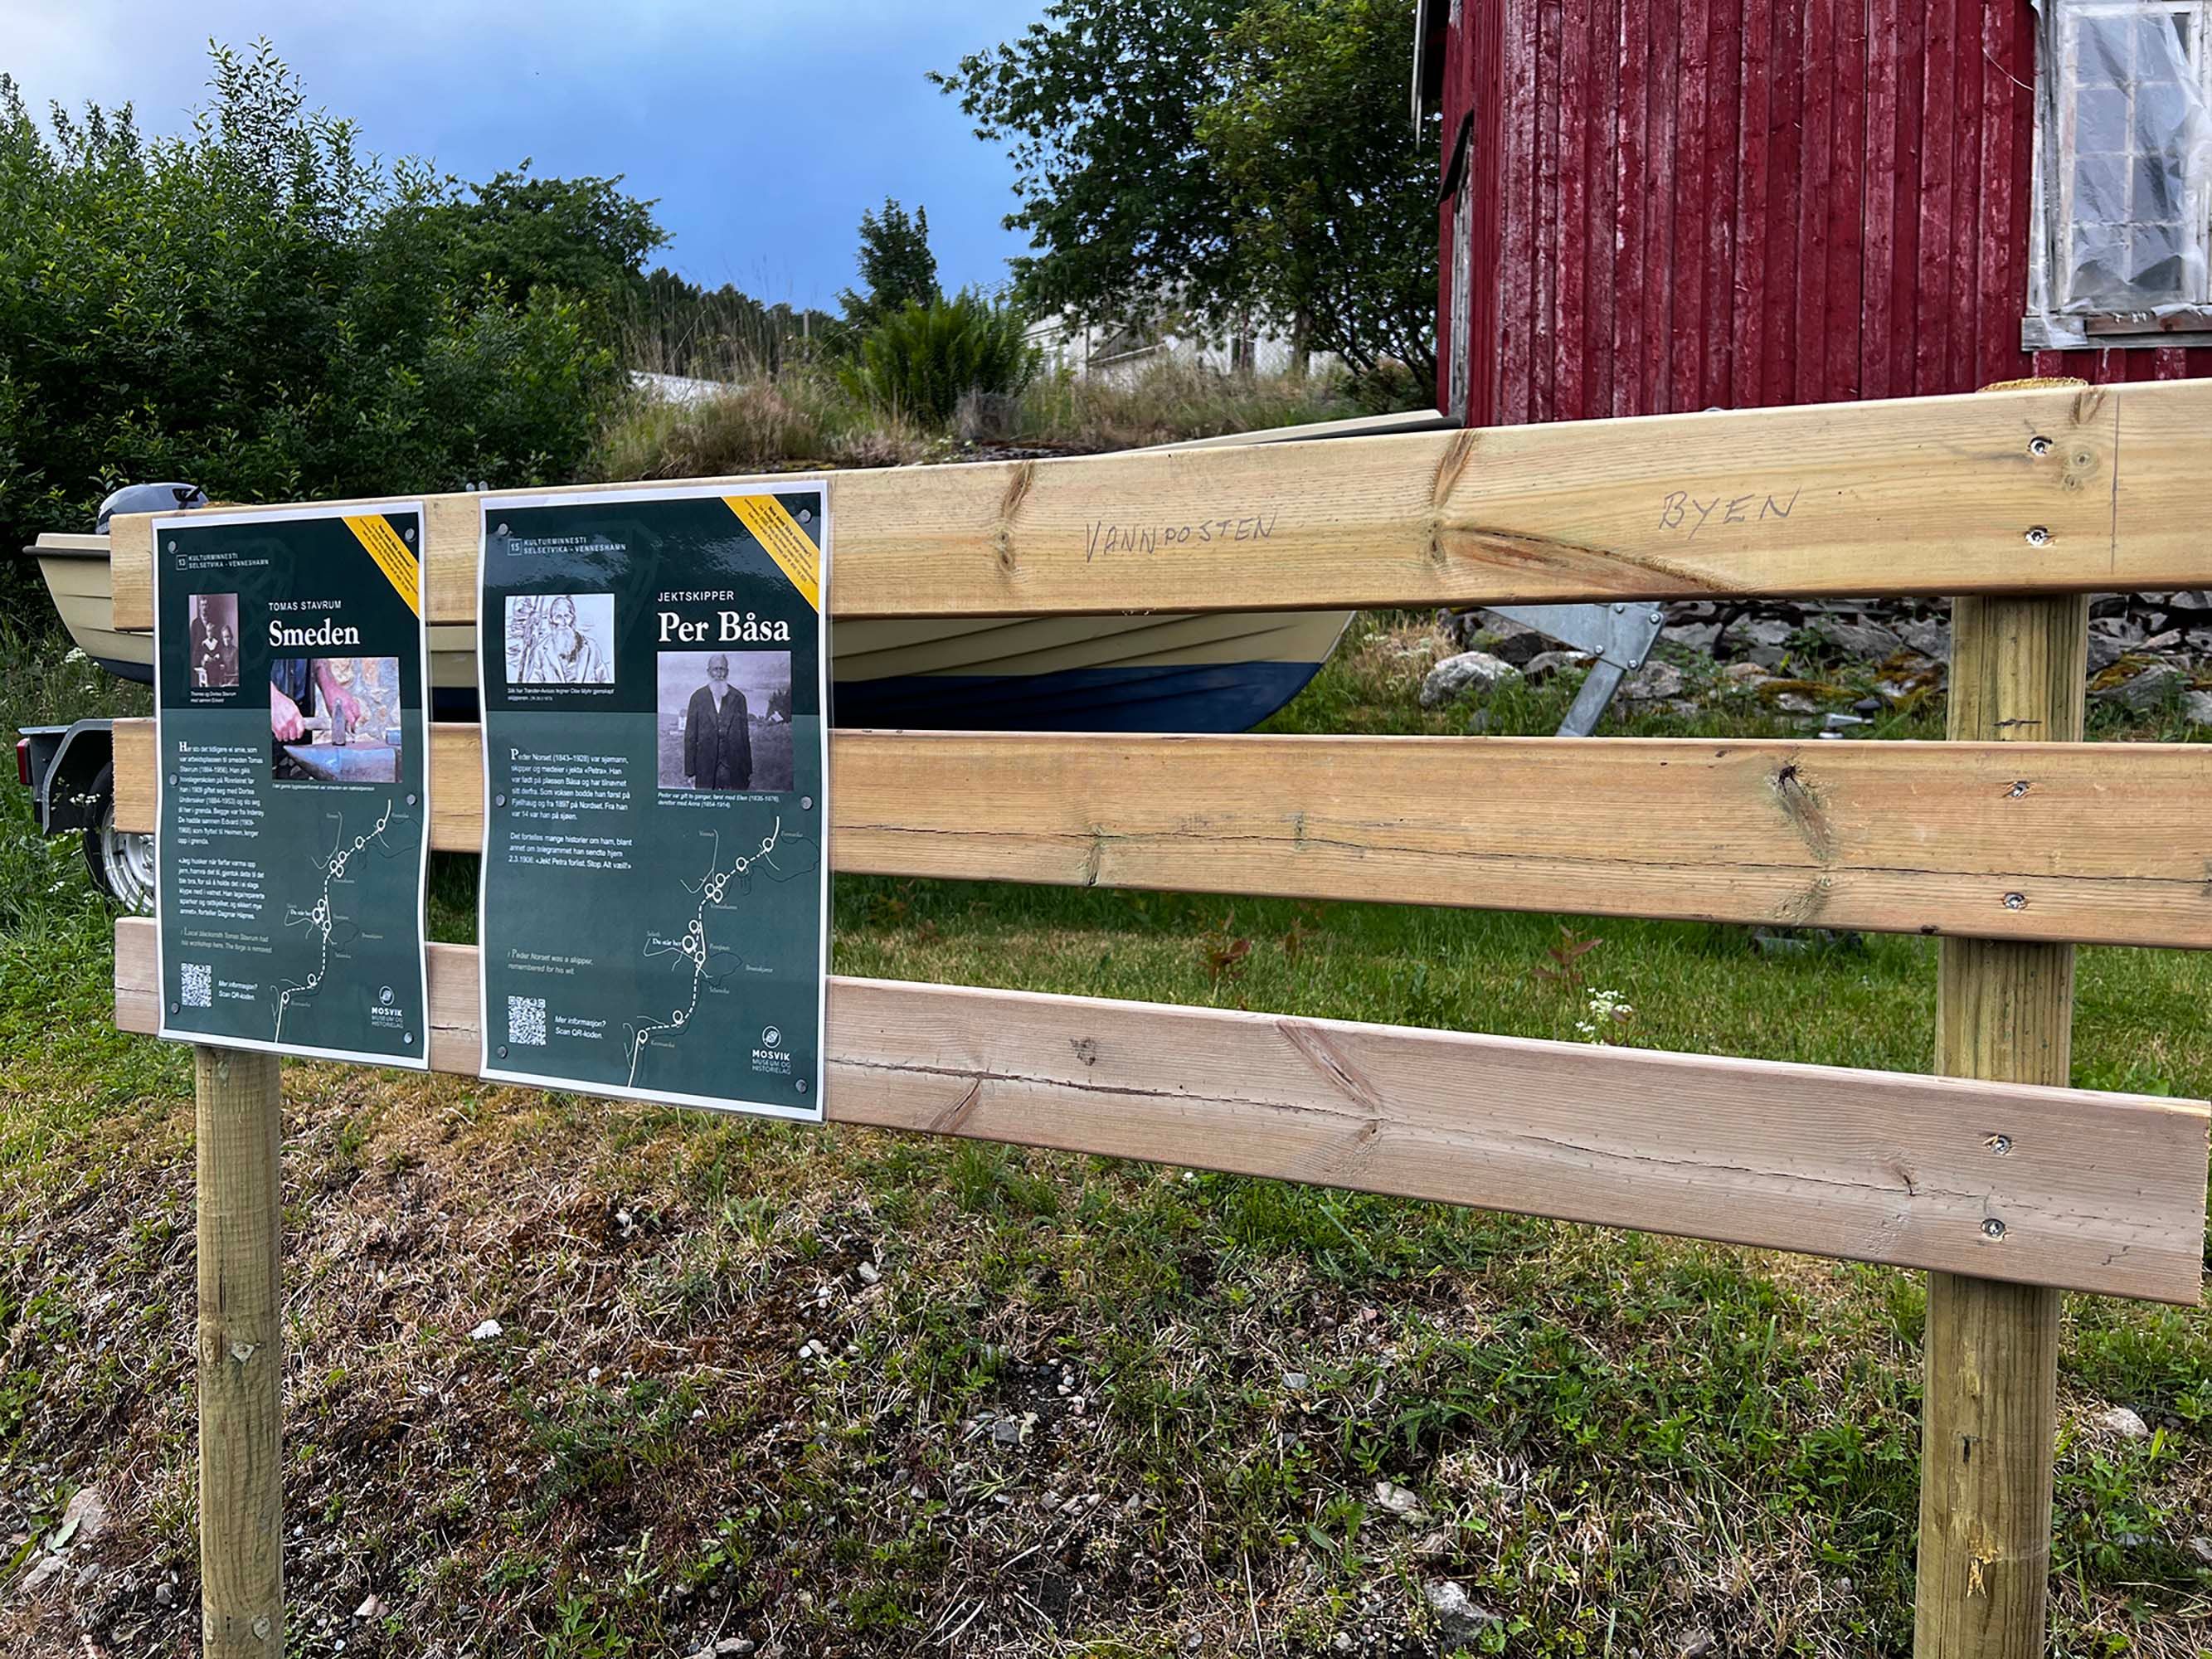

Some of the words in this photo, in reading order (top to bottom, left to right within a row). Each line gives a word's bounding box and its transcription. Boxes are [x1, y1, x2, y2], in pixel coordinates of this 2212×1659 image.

[1659, 485, 1802, 540] BYEN
[524, 537, 587, 546] KULTURMINNESTI
[1086, 510, 1278, 563] VANNPOSTEN
[524, 546, 568, 555] SELSETVIKA
[575, 544, 626, 552] VENNESHAMN
[188, 552, 239, 561] KULTURMINNESTI
[658, 590, 735, 602] JEKTSKIPPER
[268, 601, 299, 611] TOMAS
[300, 601, 342, 611] STAVRUM
[658, 611, 709, 642] Per
[717, 611, 791, 642] Båsa
[269, 617, 361, 647] Smeden
[510, 748, 532, 760] Peder
[511, 766, 532, 774] skipper
[542, 777, 565, 786] plassen
[622, 791, 630, 800] på
[570, 801, 578, 810] på
[551, 812, 559, 820] på
[545, 835, 564, 844] mange
[607, 850, 623, 859] hjem
[371, 1006, 403, 1017] MOSVIK
[568, 1017, 606, 1028] informasjon?
[555, 1027, 571, 1036] Scan
[752, 1048, 790, 1062] MOSVIK
